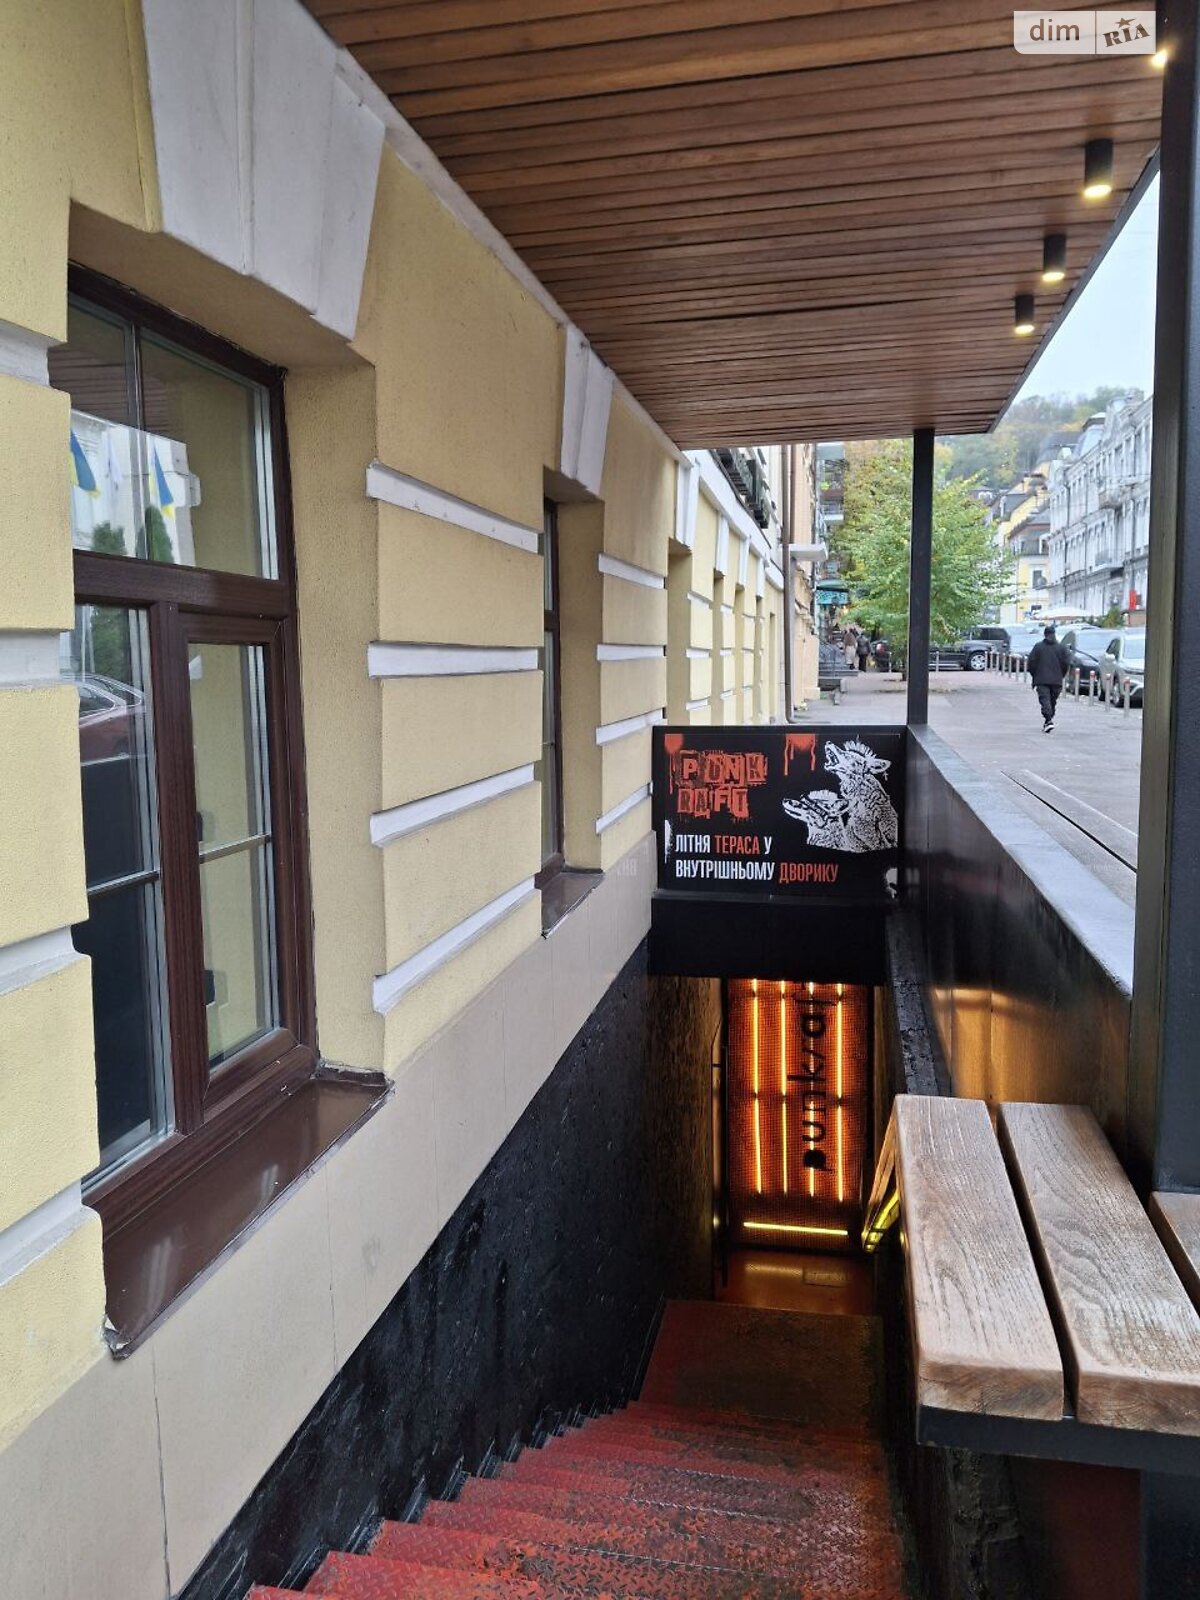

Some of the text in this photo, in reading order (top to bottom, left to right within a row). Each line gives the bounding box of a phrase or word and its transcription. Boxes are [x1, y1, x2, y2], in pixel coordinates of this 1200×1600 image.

[681, 750, 767, 786] PUNK
[677, 787, 749, 819] RAFT
[675, 834, 772, 855] ЛІТНЯ ТЕРАСА У
[675, 861, 839, 884] ВНУТРІШНЬОМУ ДВОРИКУ
